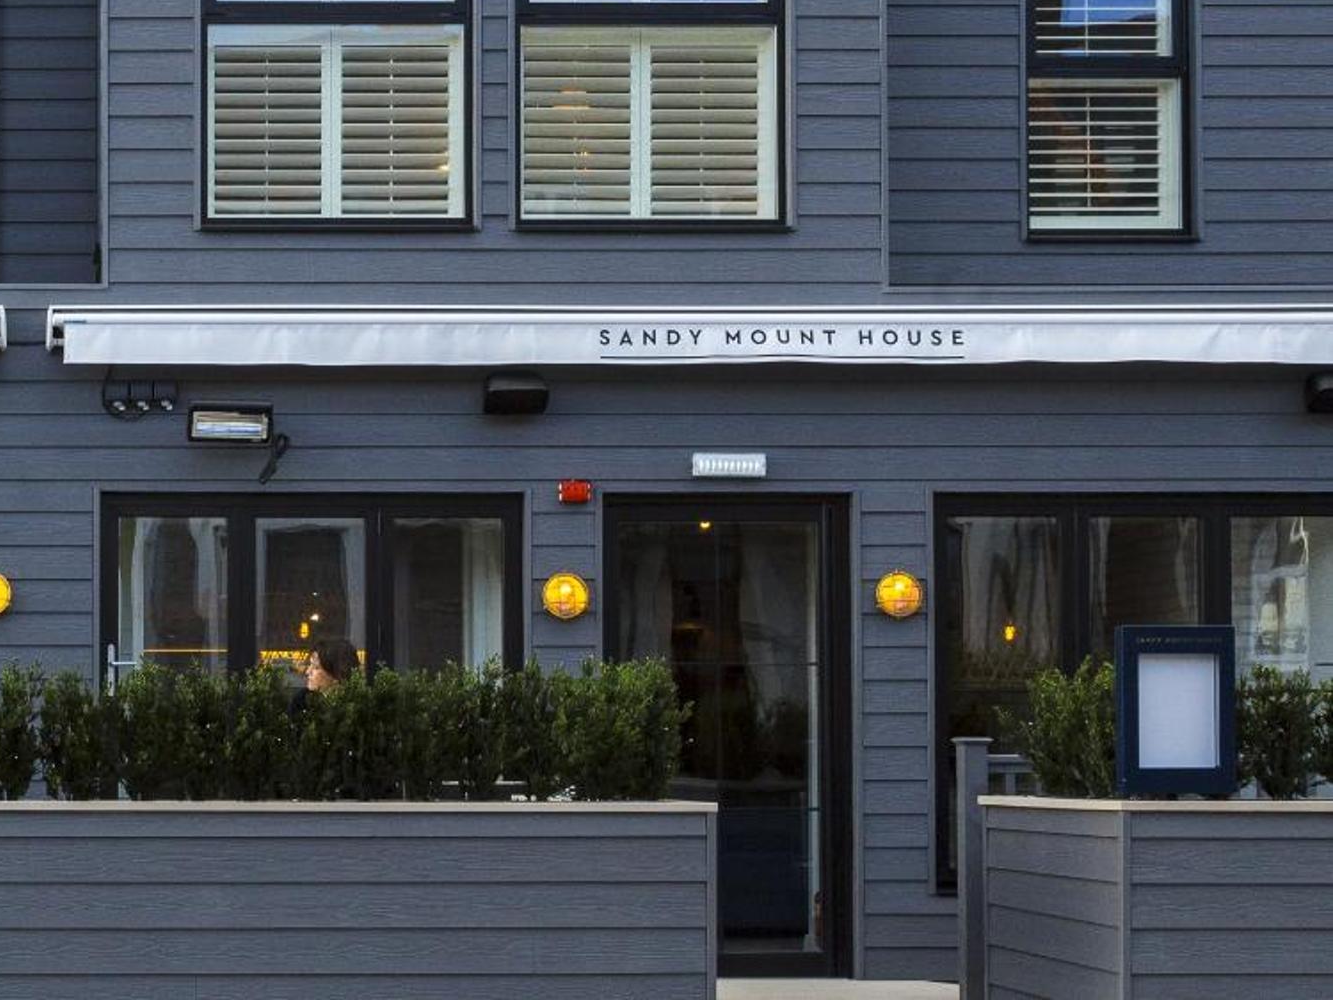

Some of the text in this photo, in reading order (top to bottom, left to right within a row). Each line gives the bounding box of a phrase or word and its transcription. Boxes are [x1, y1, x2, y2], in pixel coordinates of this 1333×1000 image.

[599, 329, 965, 346] SANDY MOUNT HOUSE
